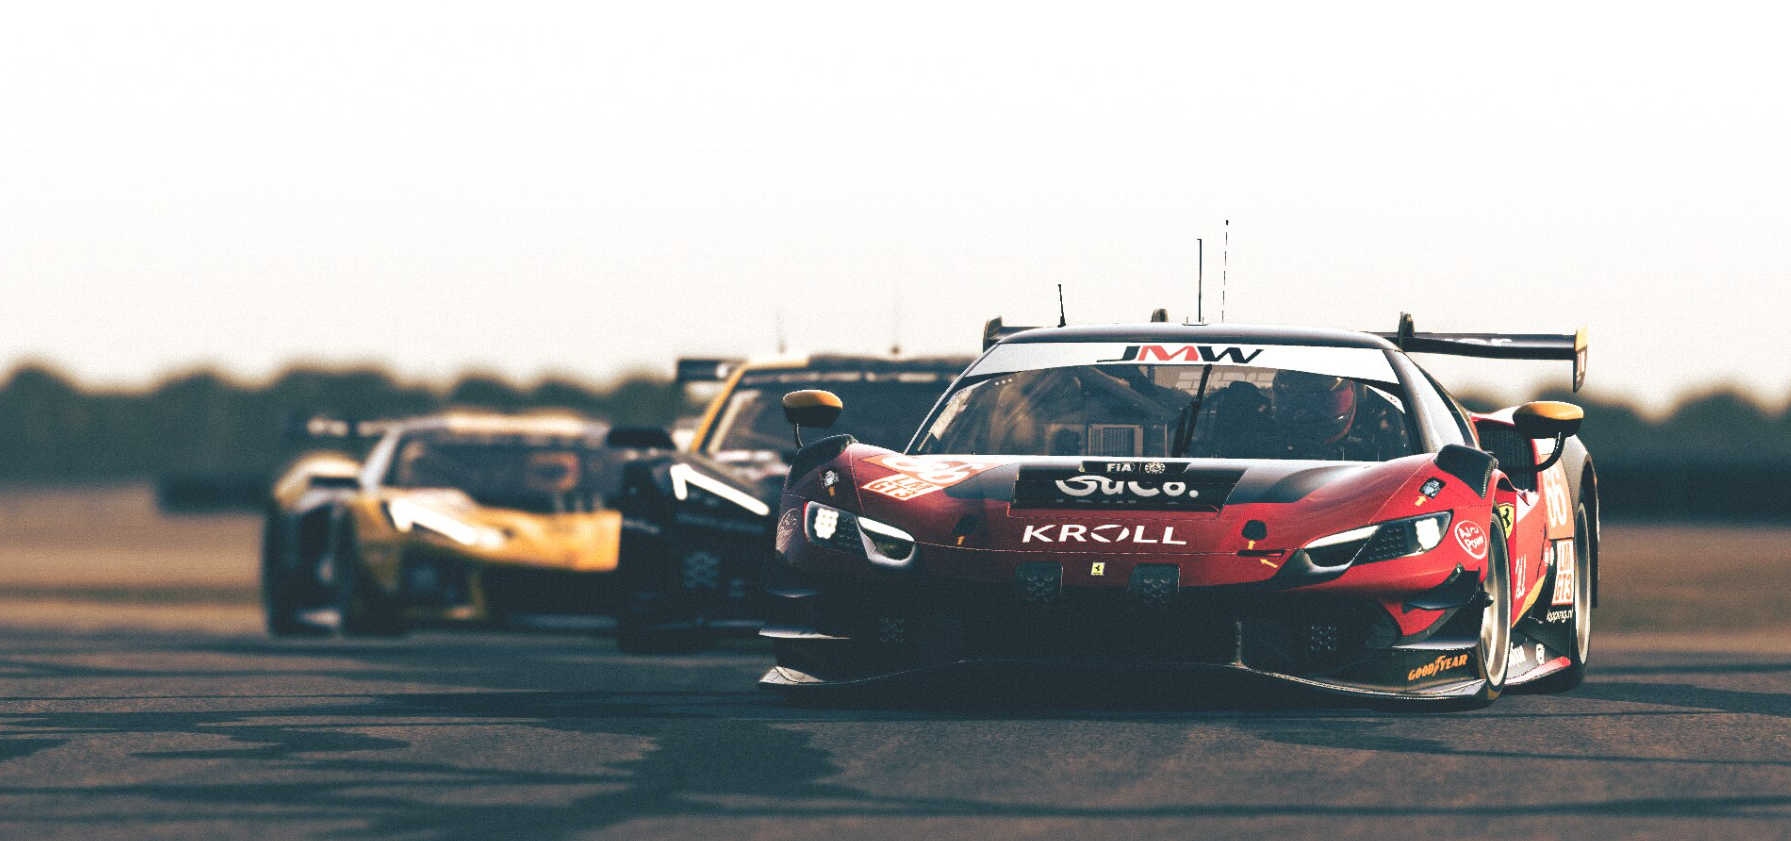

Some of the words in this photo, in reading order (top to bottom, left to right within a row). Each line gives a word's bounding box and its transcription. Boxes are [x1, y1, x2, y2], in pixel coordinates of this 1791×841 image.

[1097, 345, 1265, 364] JMW
[1106, 462, 1134, 473] FIA
[1022, 524, 1188, 545] KROLL
[1555, 573, 1572, 601] GT3
[1408, 654, 1468, 681] GOODYEAR
